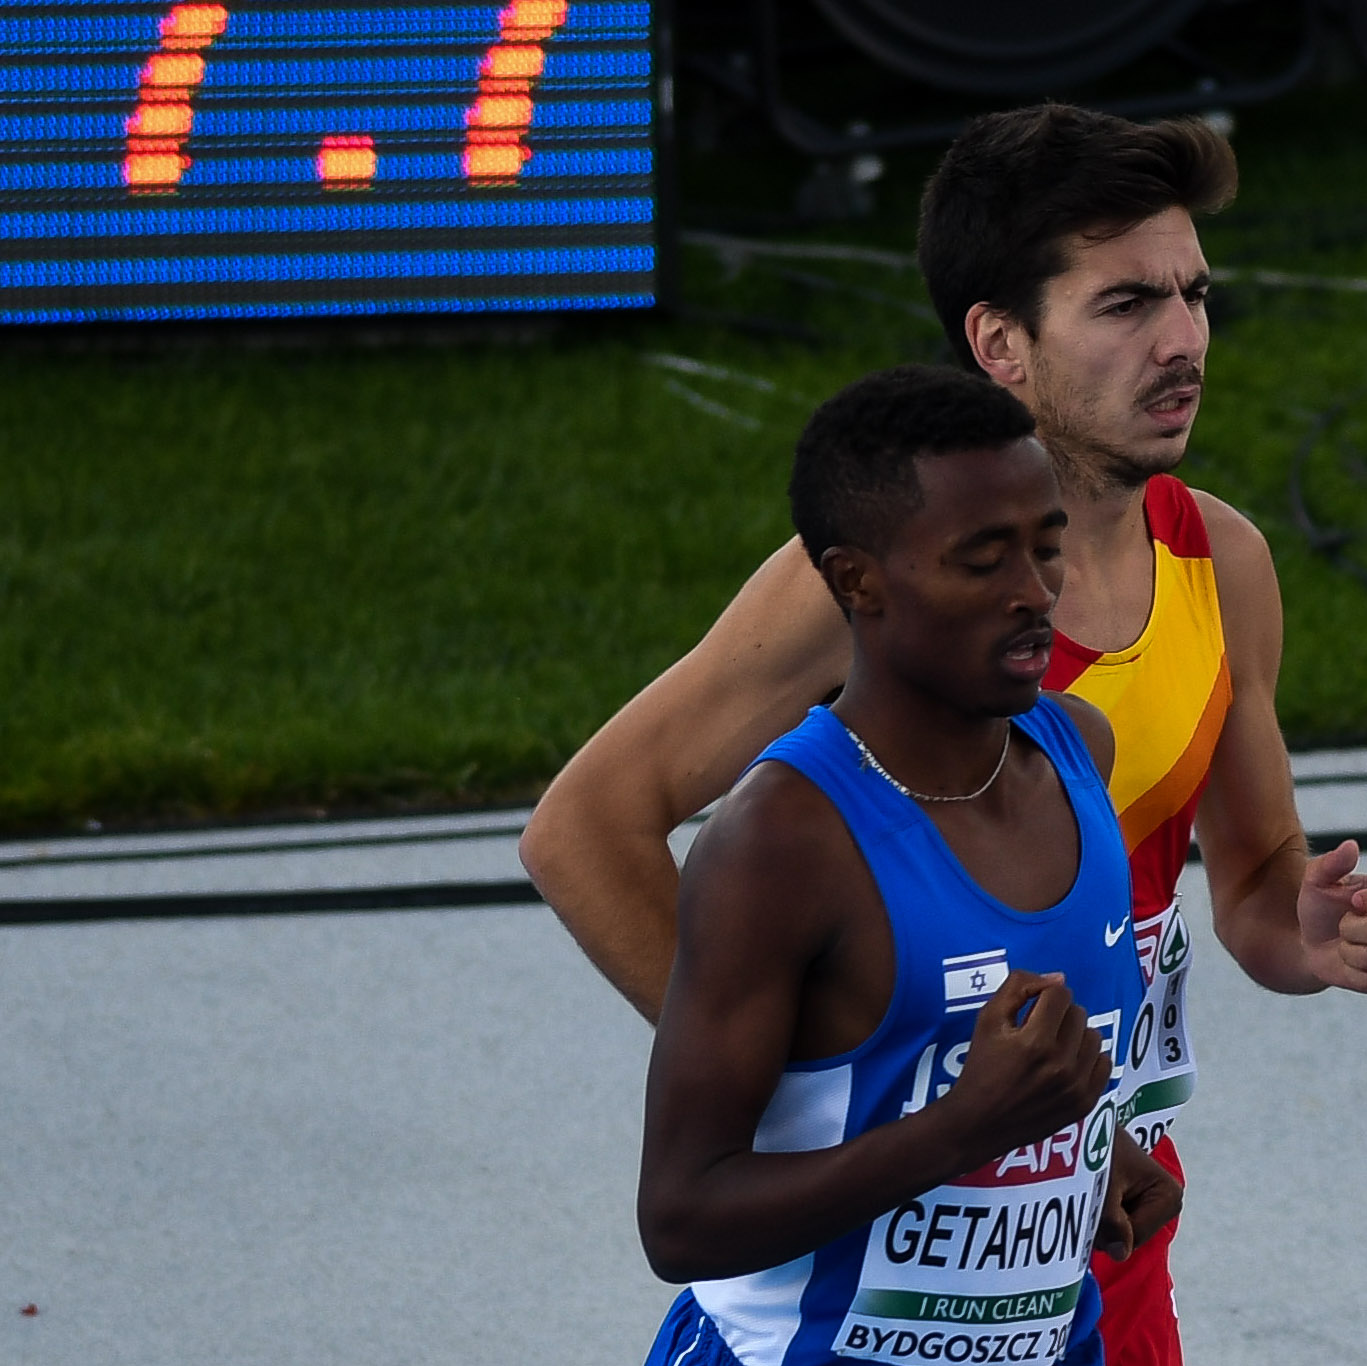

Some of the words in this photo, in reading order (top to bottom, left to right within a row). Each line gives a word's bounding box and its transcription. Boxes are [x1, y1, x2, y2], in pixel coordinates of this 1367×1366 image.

[885, 1192, 1087, 1270] GETAHON
[918, 1296, 928, 1317] I
[933, 1299, 987, 1321] RUN
[845, 1324, 1044, 1364] BYDGOSZCZ
